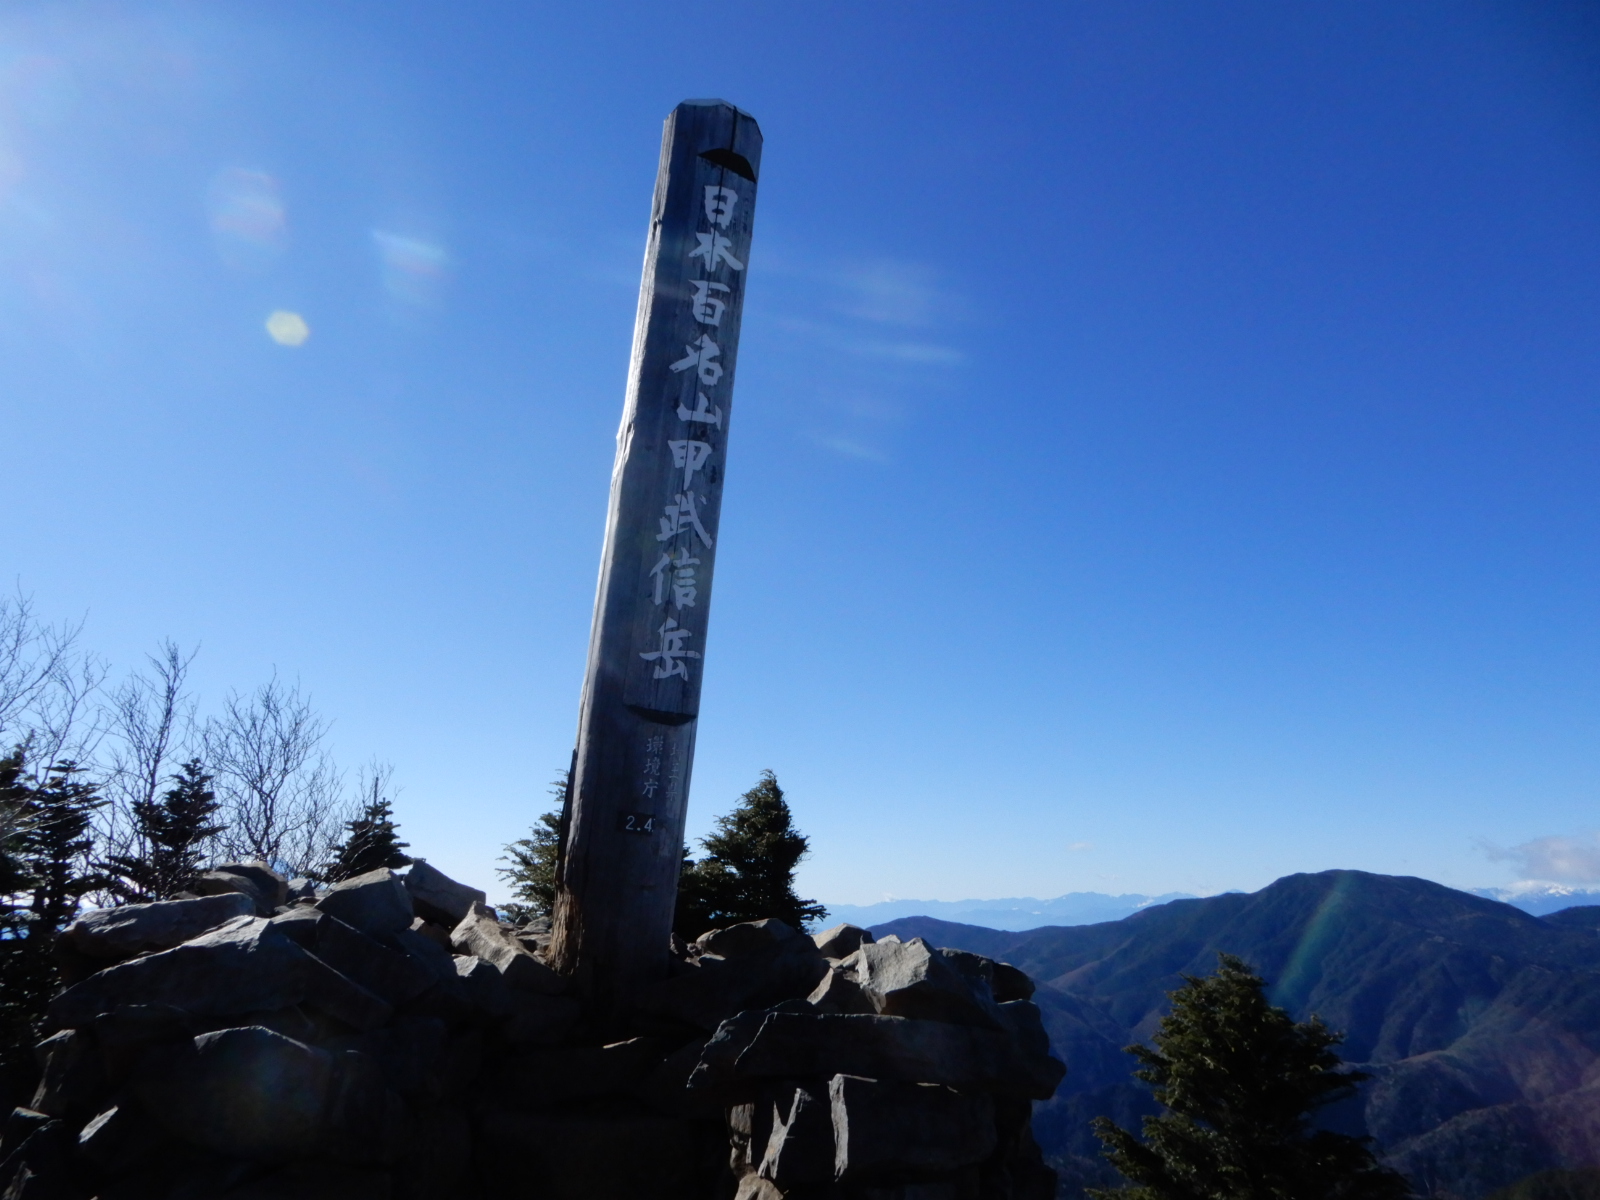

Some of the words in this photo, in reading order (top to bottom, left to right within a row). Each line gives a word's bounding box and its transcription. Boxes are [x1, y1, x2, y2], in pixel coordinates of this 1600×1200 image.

[639, 185, 744, 681] 日本百名山甲武信岳
[643, 735, 664, 799] 環境庁
[625, 815, 653, 832] 2.4
